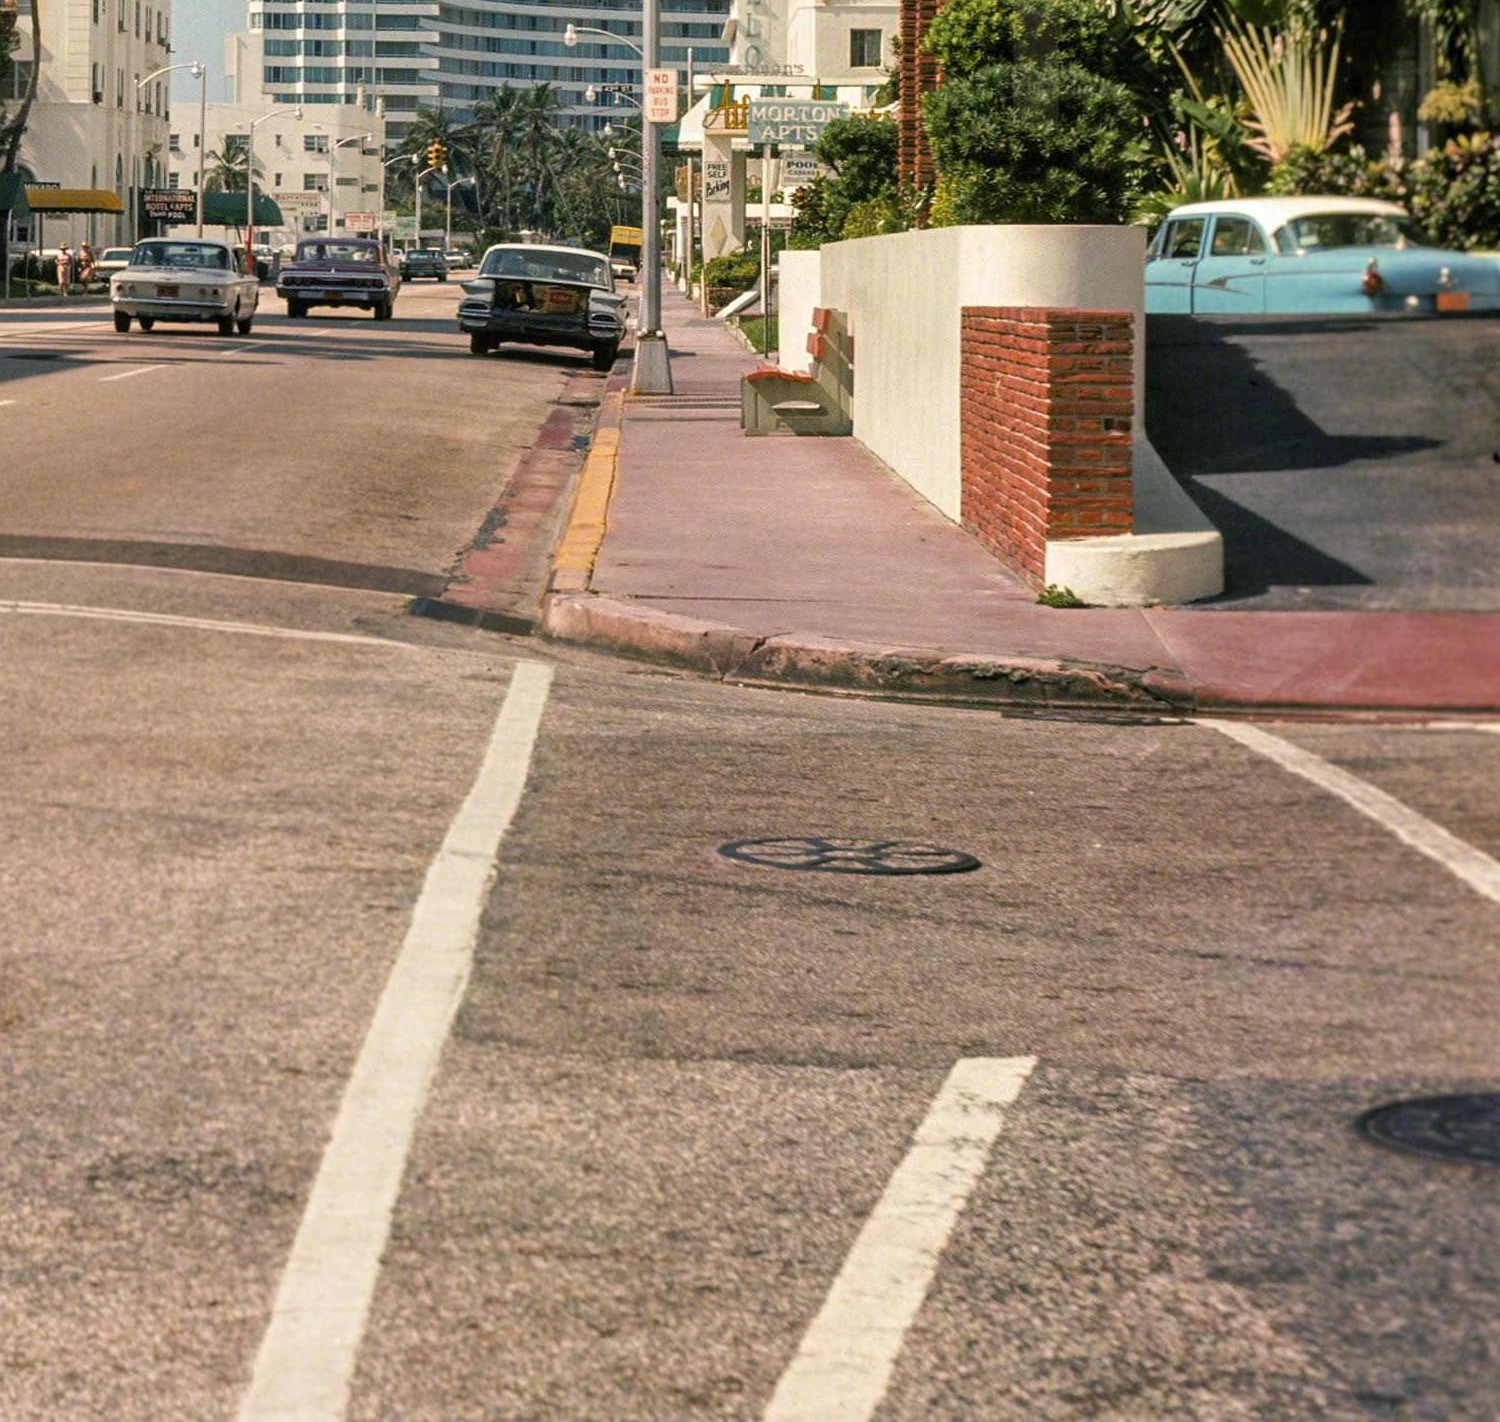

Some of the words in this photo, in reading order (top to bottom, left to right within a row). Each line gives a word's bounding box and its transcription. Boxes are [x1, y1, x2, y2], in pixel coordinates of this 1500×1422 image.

[653, 74, 669, 84] NO
[648, 86, 674, 95] PARKING
[653, 97, 668, 106] BUS
[651, 108, 670, 117] STOP
[752, 105, 841, 123] MORTON
[707, 163, 728, 171] FREE
[707, 171, 728, 179] SELF
[705, 179, 730, 197] Parking
[144, 194, 196, 203] INTERNATIONAL
[145, 202, 169, 211] HOTEL
[174, 202, 194, 211] APTS
